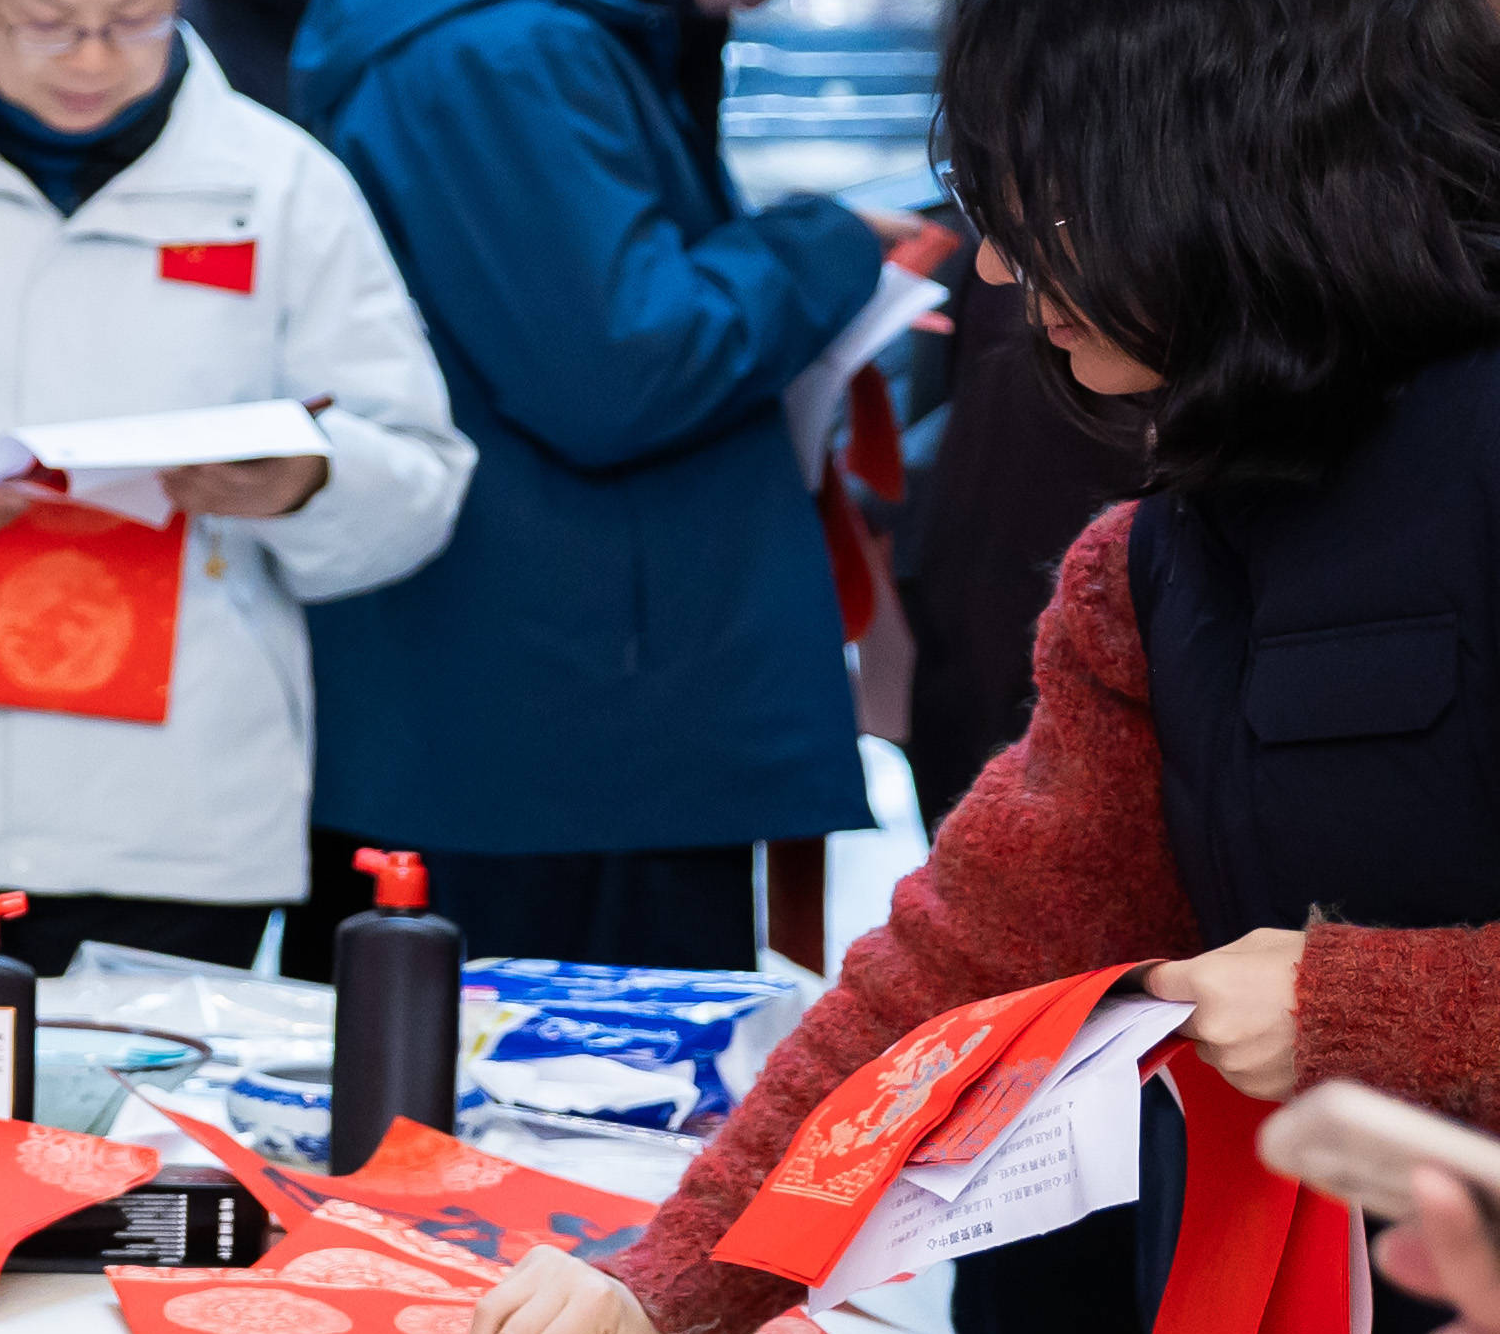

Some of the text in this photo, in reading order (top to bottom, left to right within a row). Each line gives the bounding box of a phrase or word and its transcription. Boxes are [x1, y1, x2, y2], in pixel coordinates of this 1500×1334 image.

[927, 1220, 994, 1250] 数据资源中心
